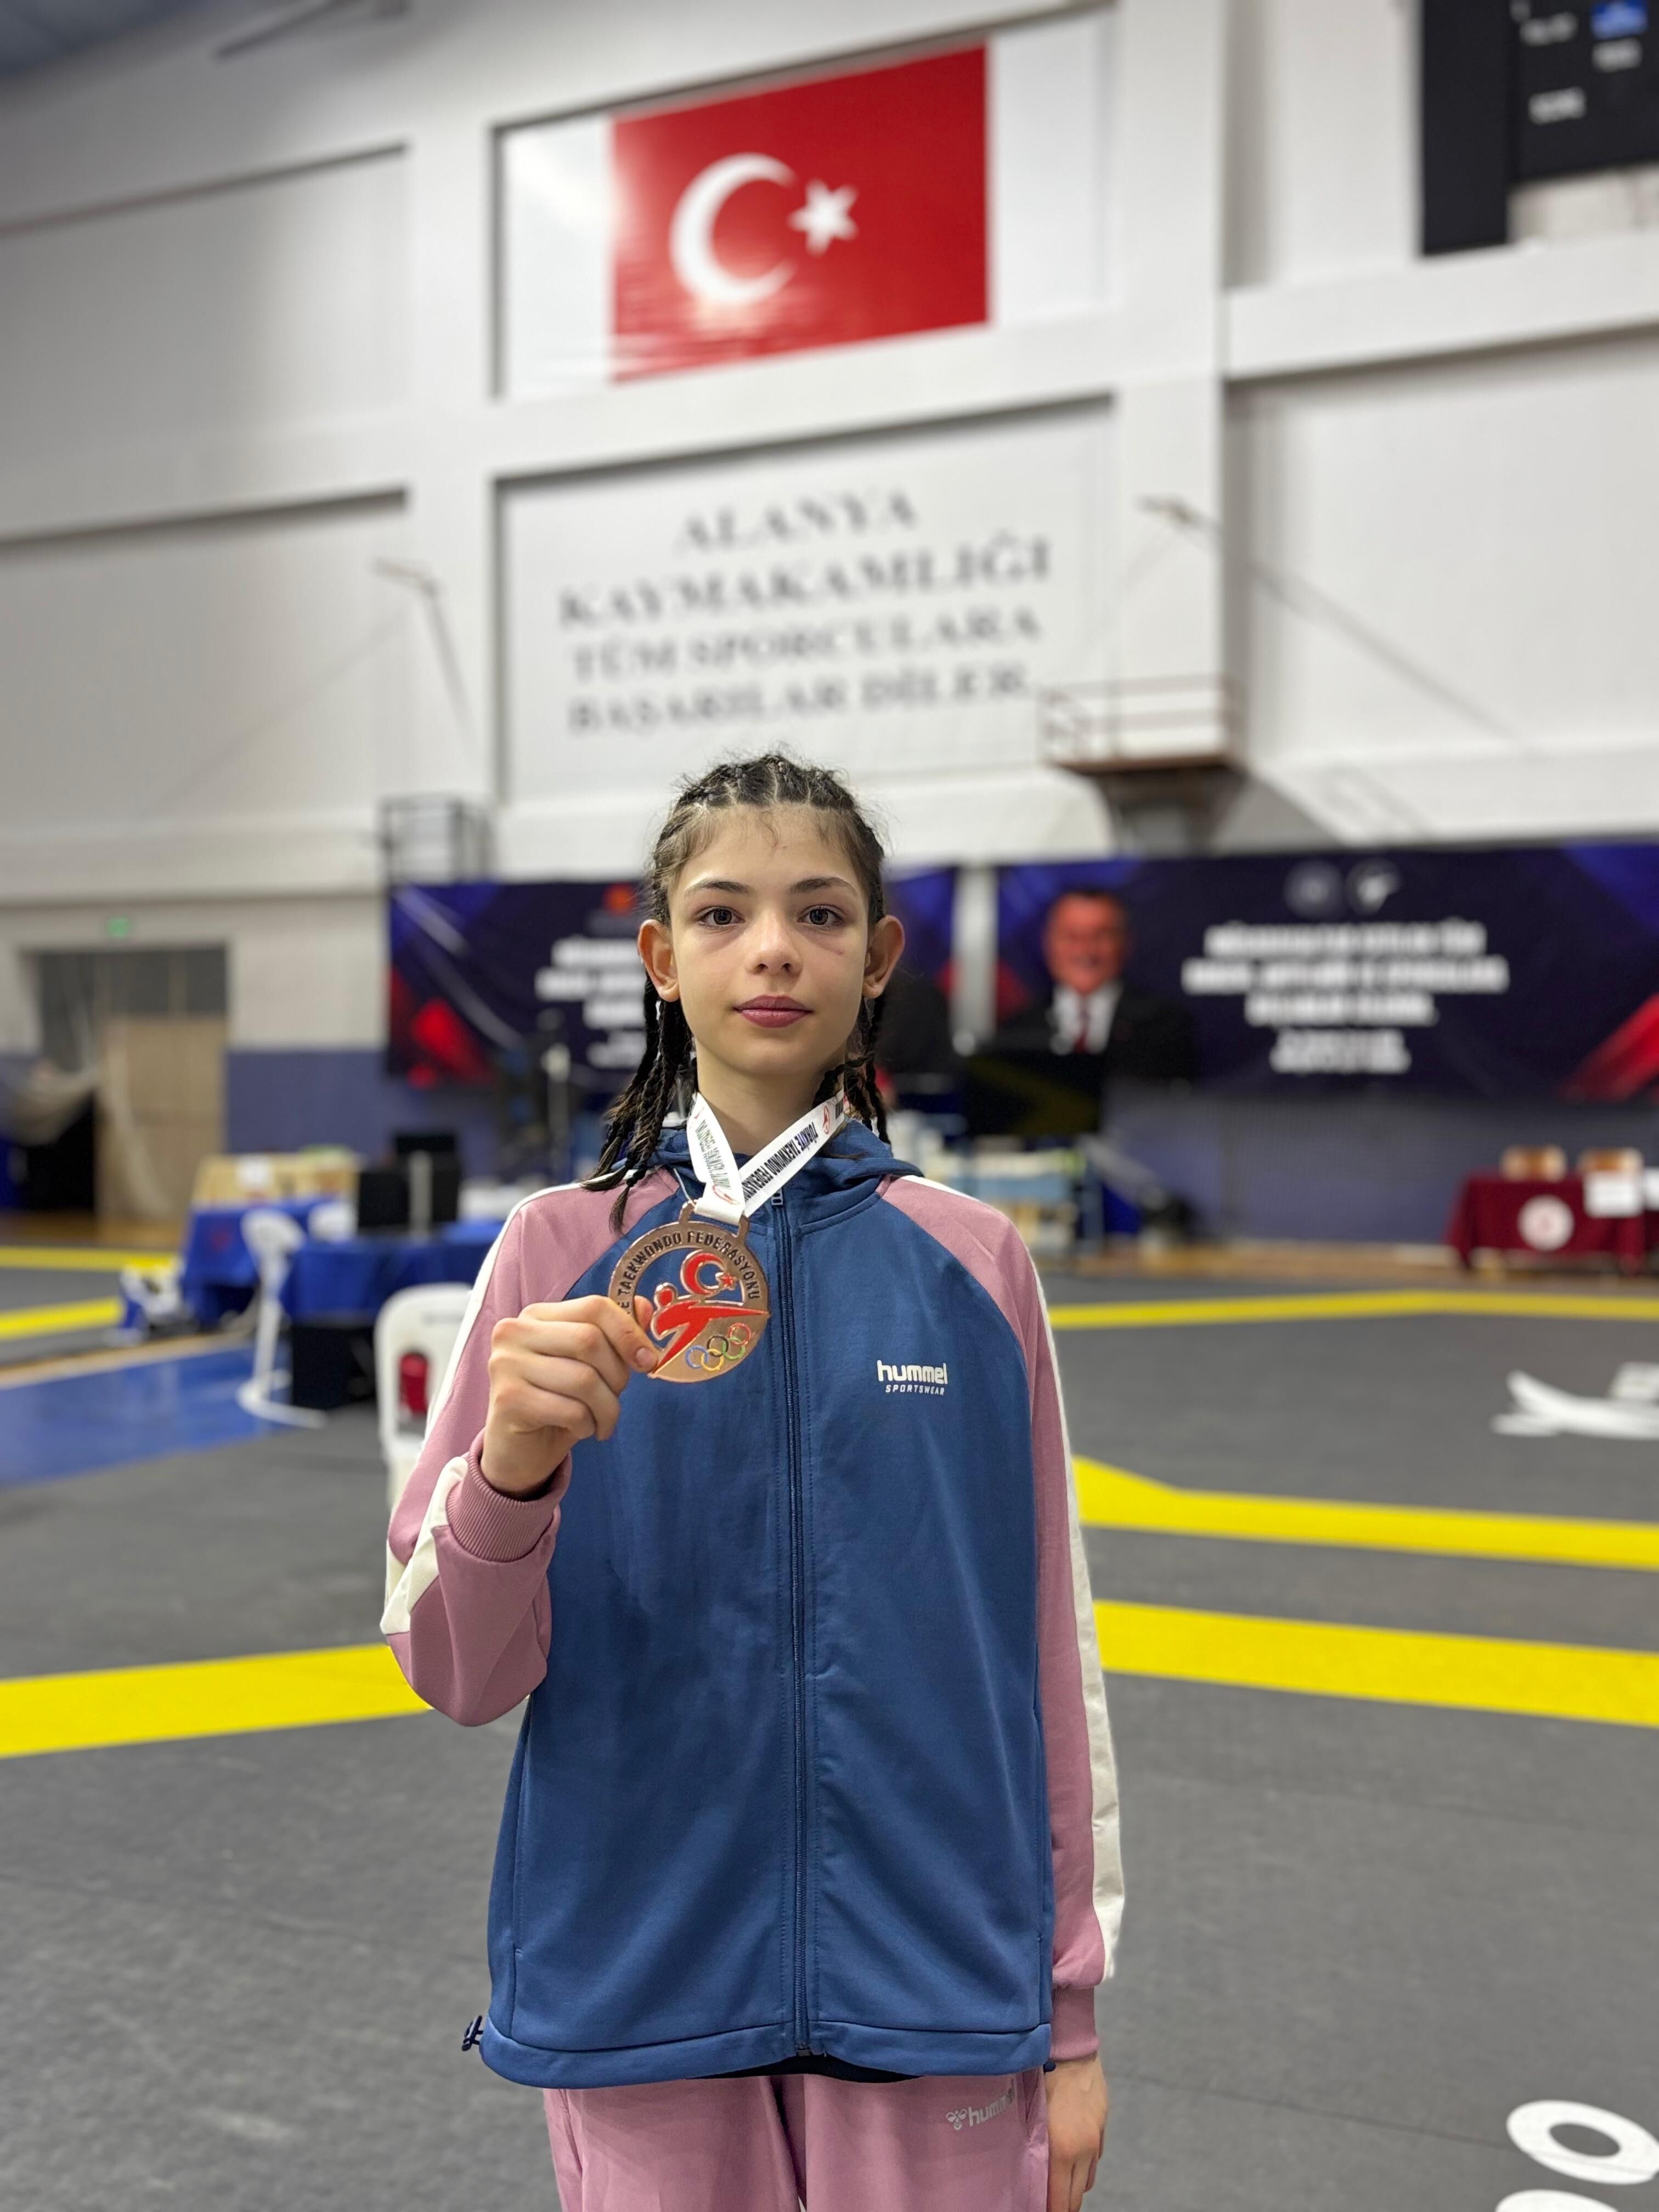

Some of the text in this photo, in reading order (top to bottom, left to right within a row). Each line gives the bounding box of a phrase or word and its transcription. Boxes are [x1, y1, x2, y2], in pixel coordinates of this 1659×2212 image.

[676, 488, 918, 554] ALANYA
[764, 1138, 801, 1176] TAEKWONDO
[617, 1231, 761, 1300] TAEKWONDO FEDERASYONU
[877, 1359, 948, 1385] hummel
[885, 1385, 945, 1396] SPORTSWEAR
